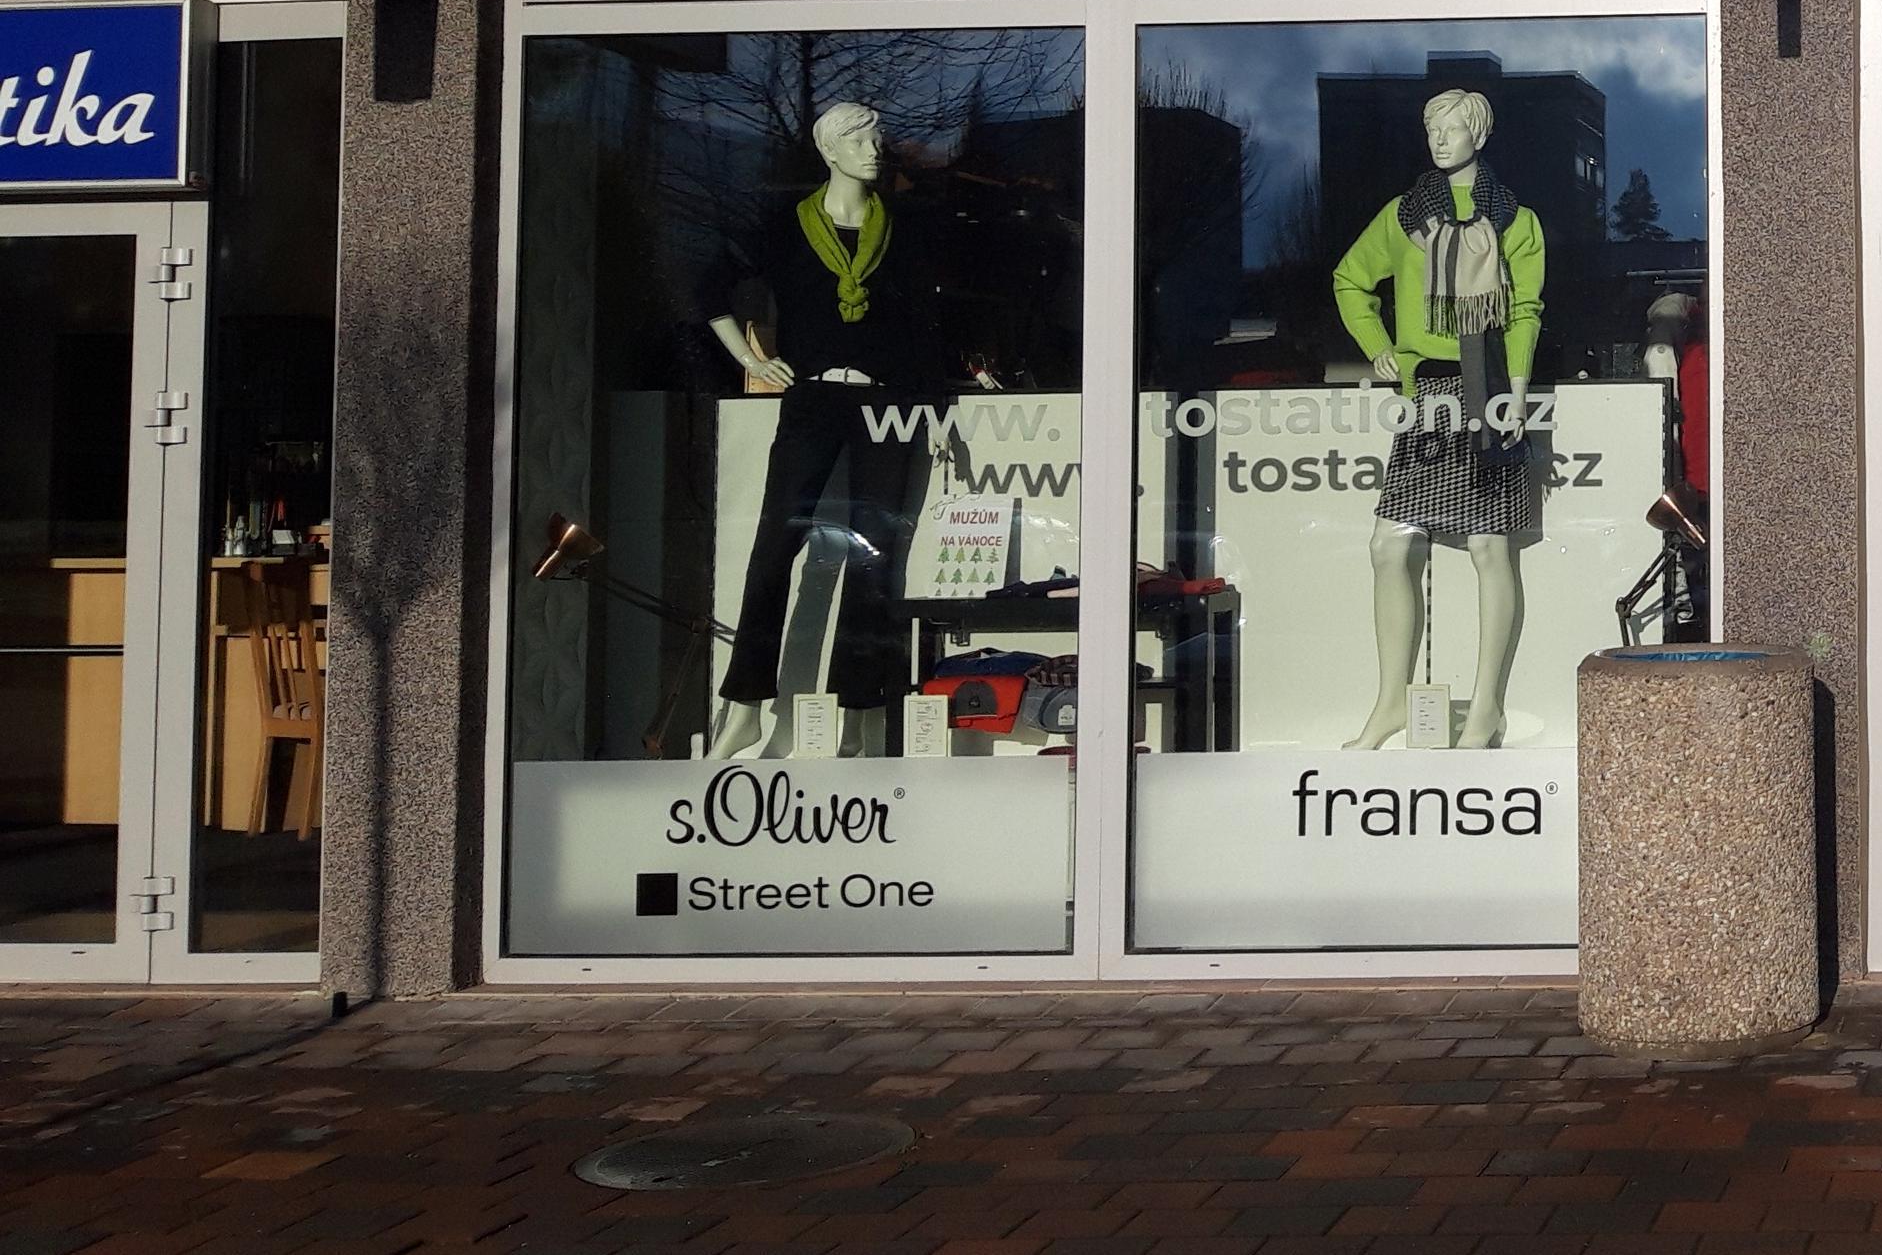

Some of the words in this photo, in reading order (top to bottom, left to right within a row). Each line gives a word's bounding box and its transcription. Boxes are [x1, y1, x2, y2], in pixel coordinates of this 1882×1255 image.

[940, 535, 955, 546] NA
[958, 533, 1003, 547] VÁNOCE
[666, 765, 897, 847] s.Oliver
[1292, 770, 1542, 837] fransa
[688, 876, 830, 911] Street
[840, 874, 934, 909] One
